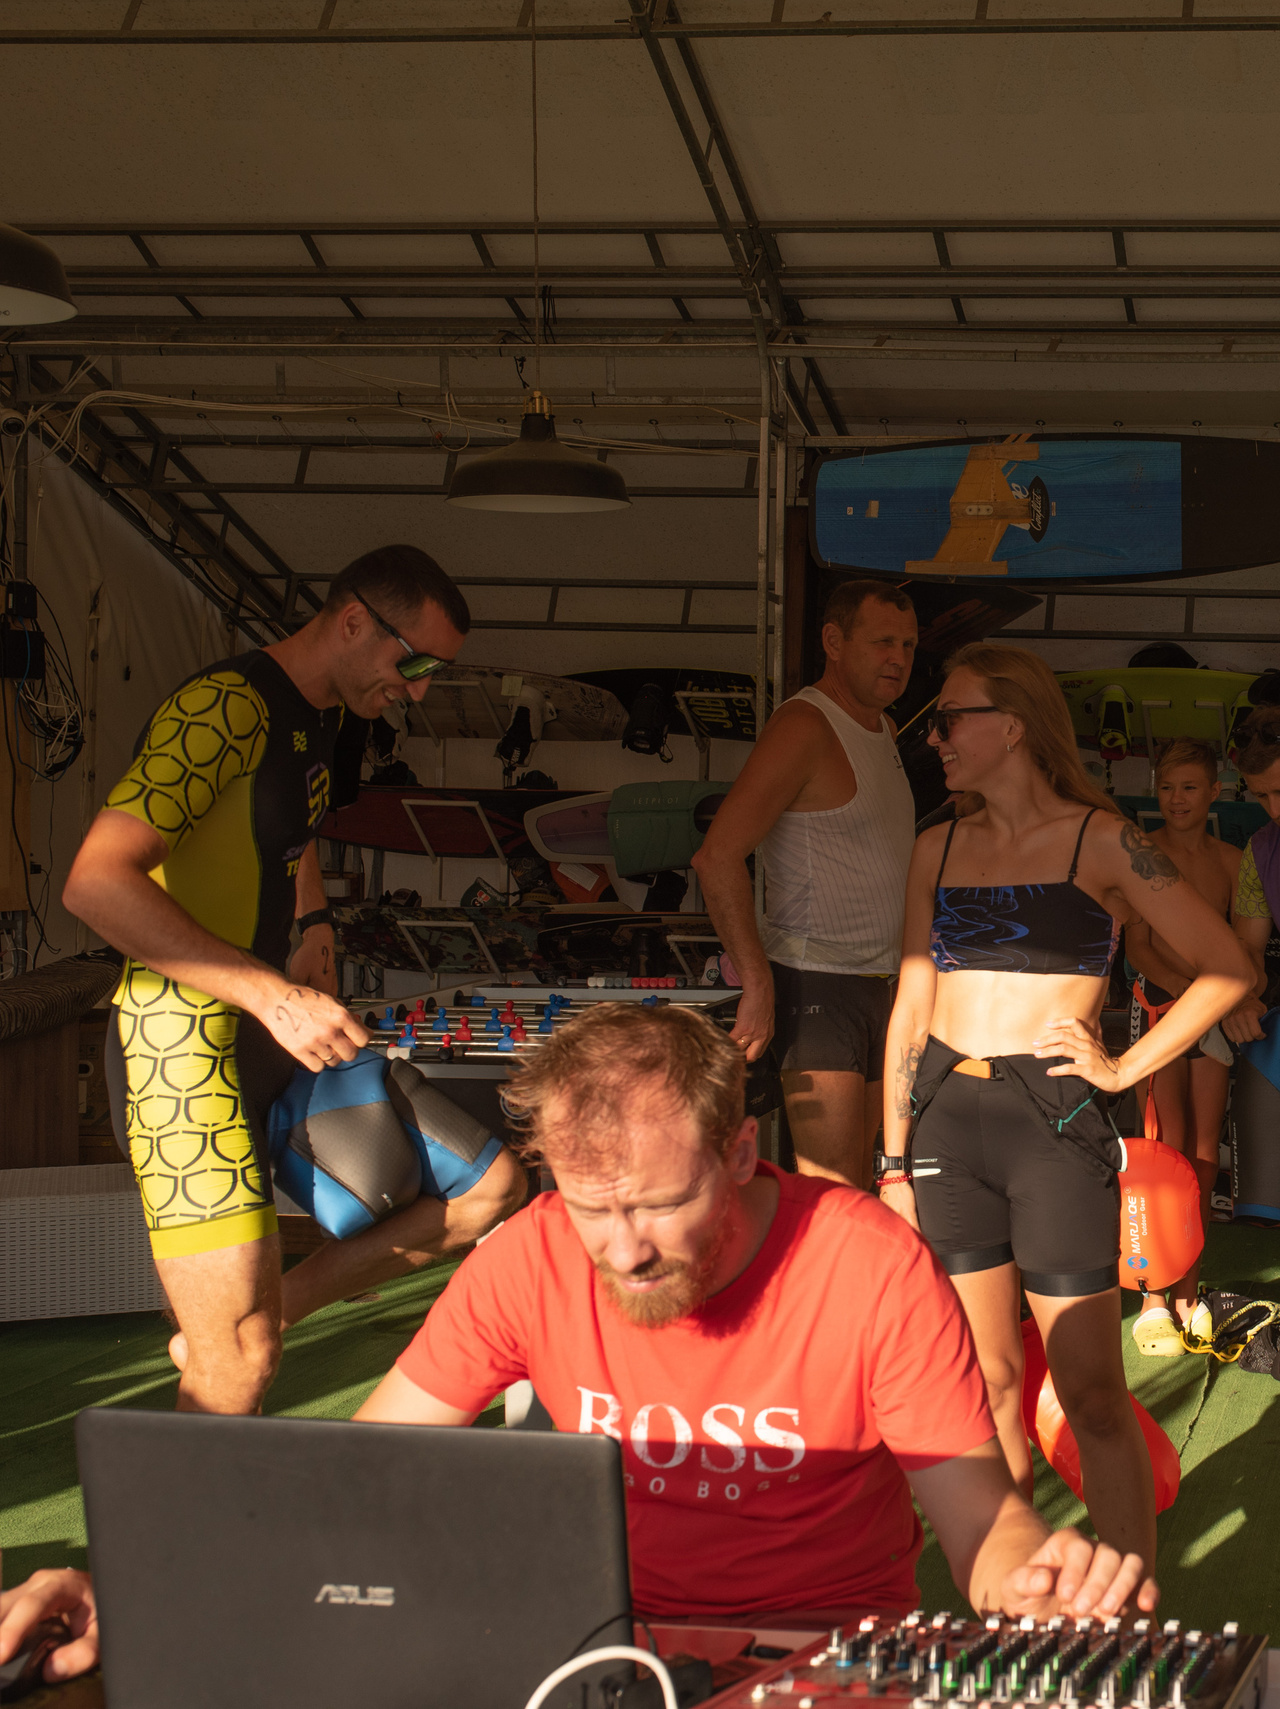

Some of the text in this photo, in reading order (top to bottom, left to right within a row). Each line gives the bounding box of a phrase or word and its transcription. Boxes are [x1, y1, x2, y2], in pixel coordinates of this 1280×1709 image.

[632, 796, 681, 806] JETPIOT
[577, 1385, 806, 1474] BOSS
[314, 1583, 396, 1607] ASUS
